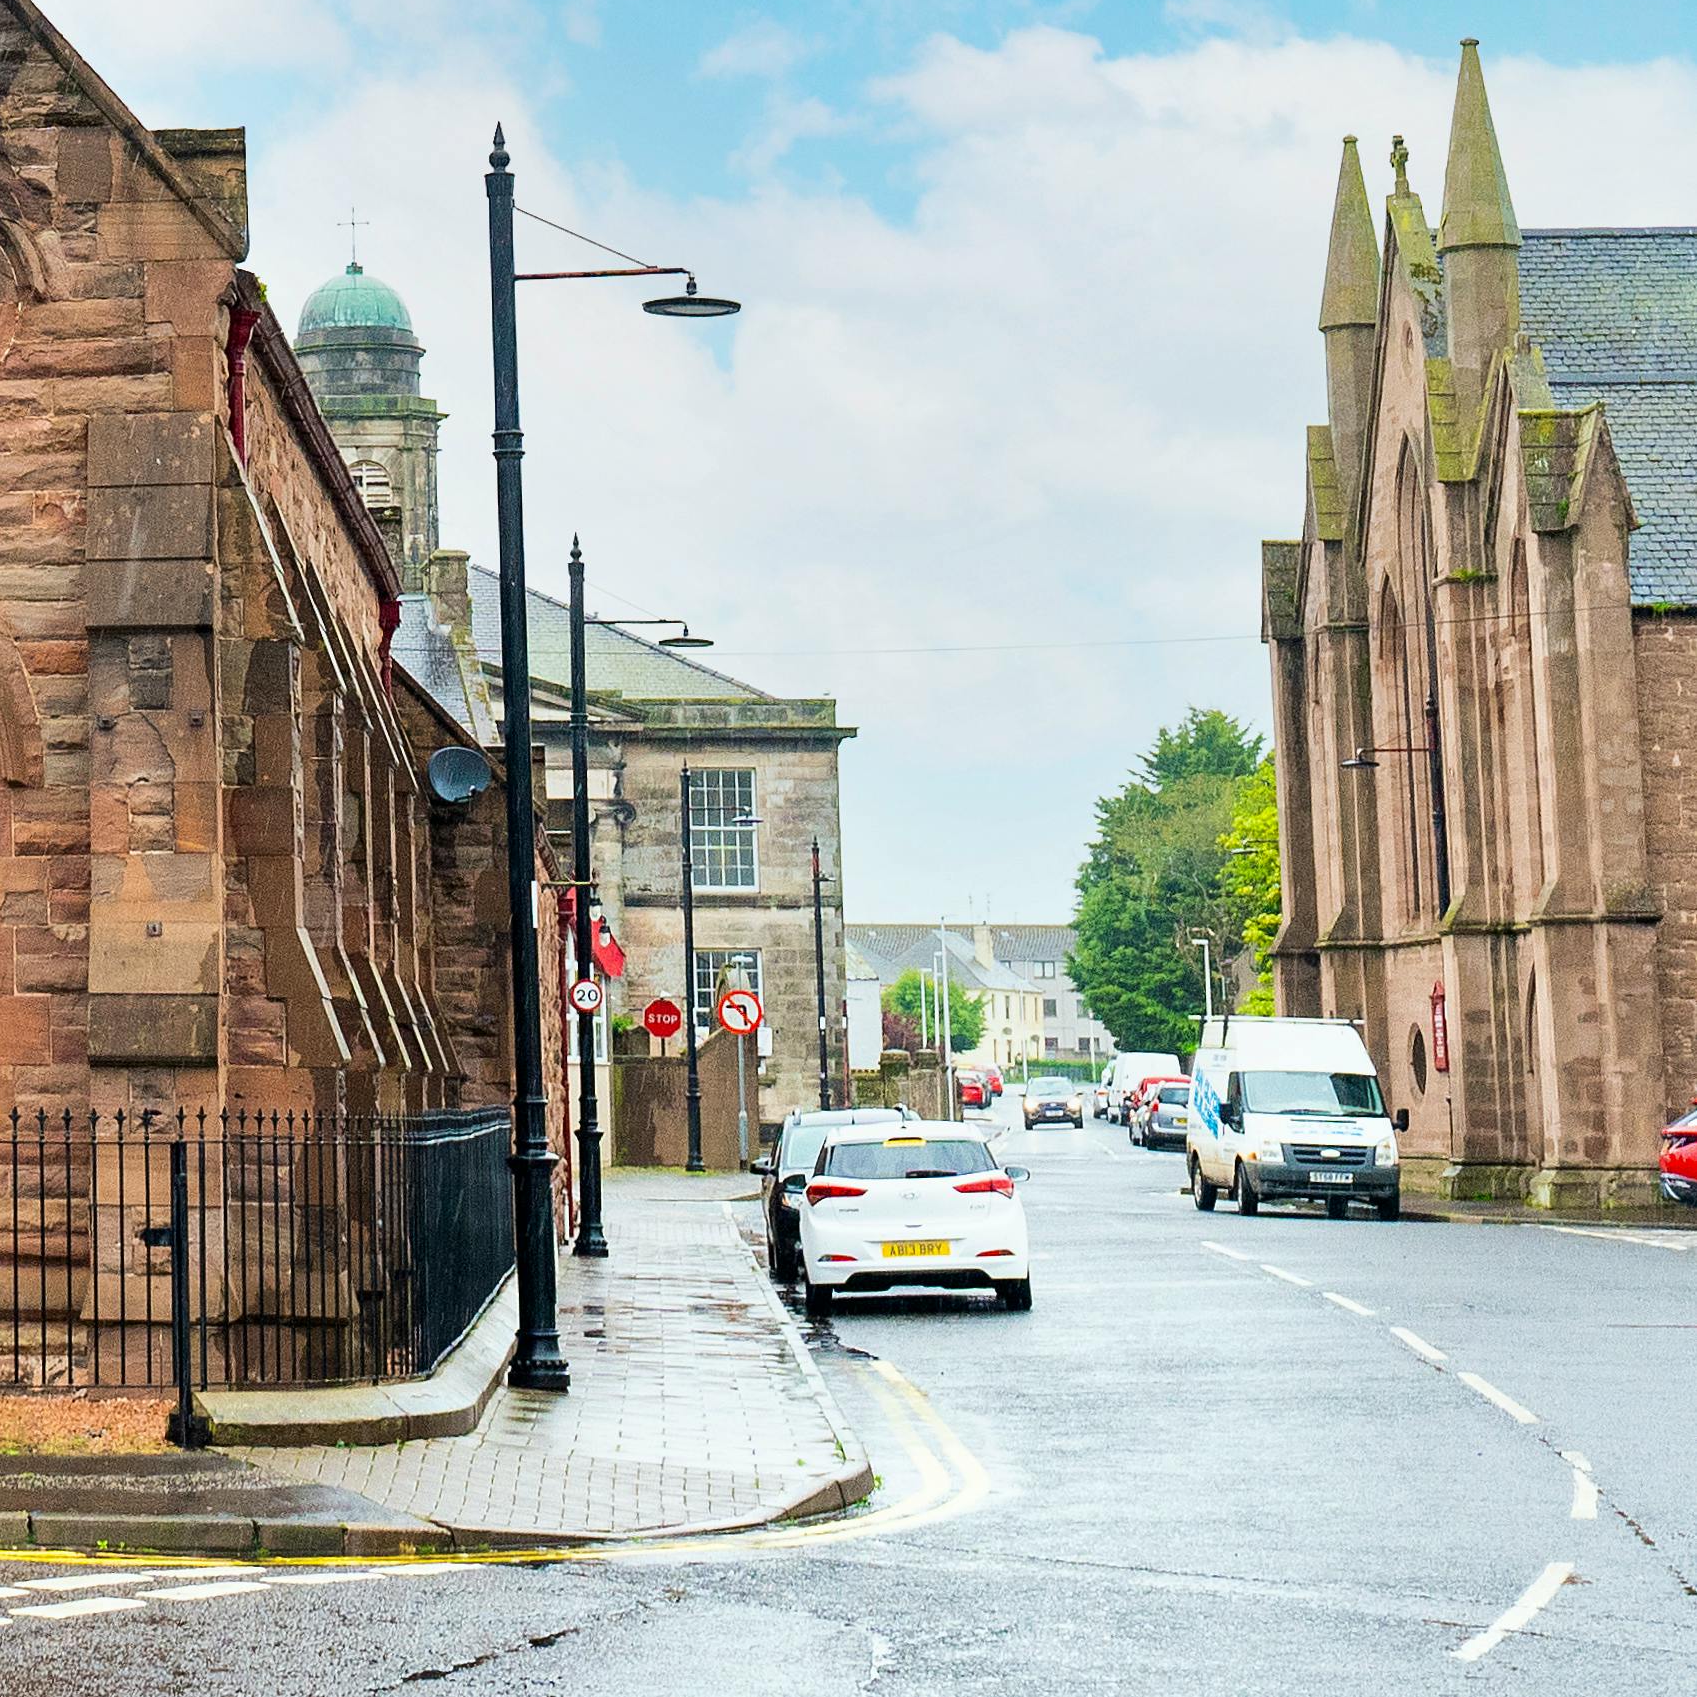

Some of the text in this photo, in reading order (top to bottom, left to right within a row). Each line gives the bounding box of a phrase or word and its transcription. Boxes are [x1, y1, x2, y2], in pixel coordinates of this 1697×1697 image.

[576, 989, 598, 1002] 20
[647, 1013, 678, 1025] STOP
[919, 1242, 942, 1255] BRY
